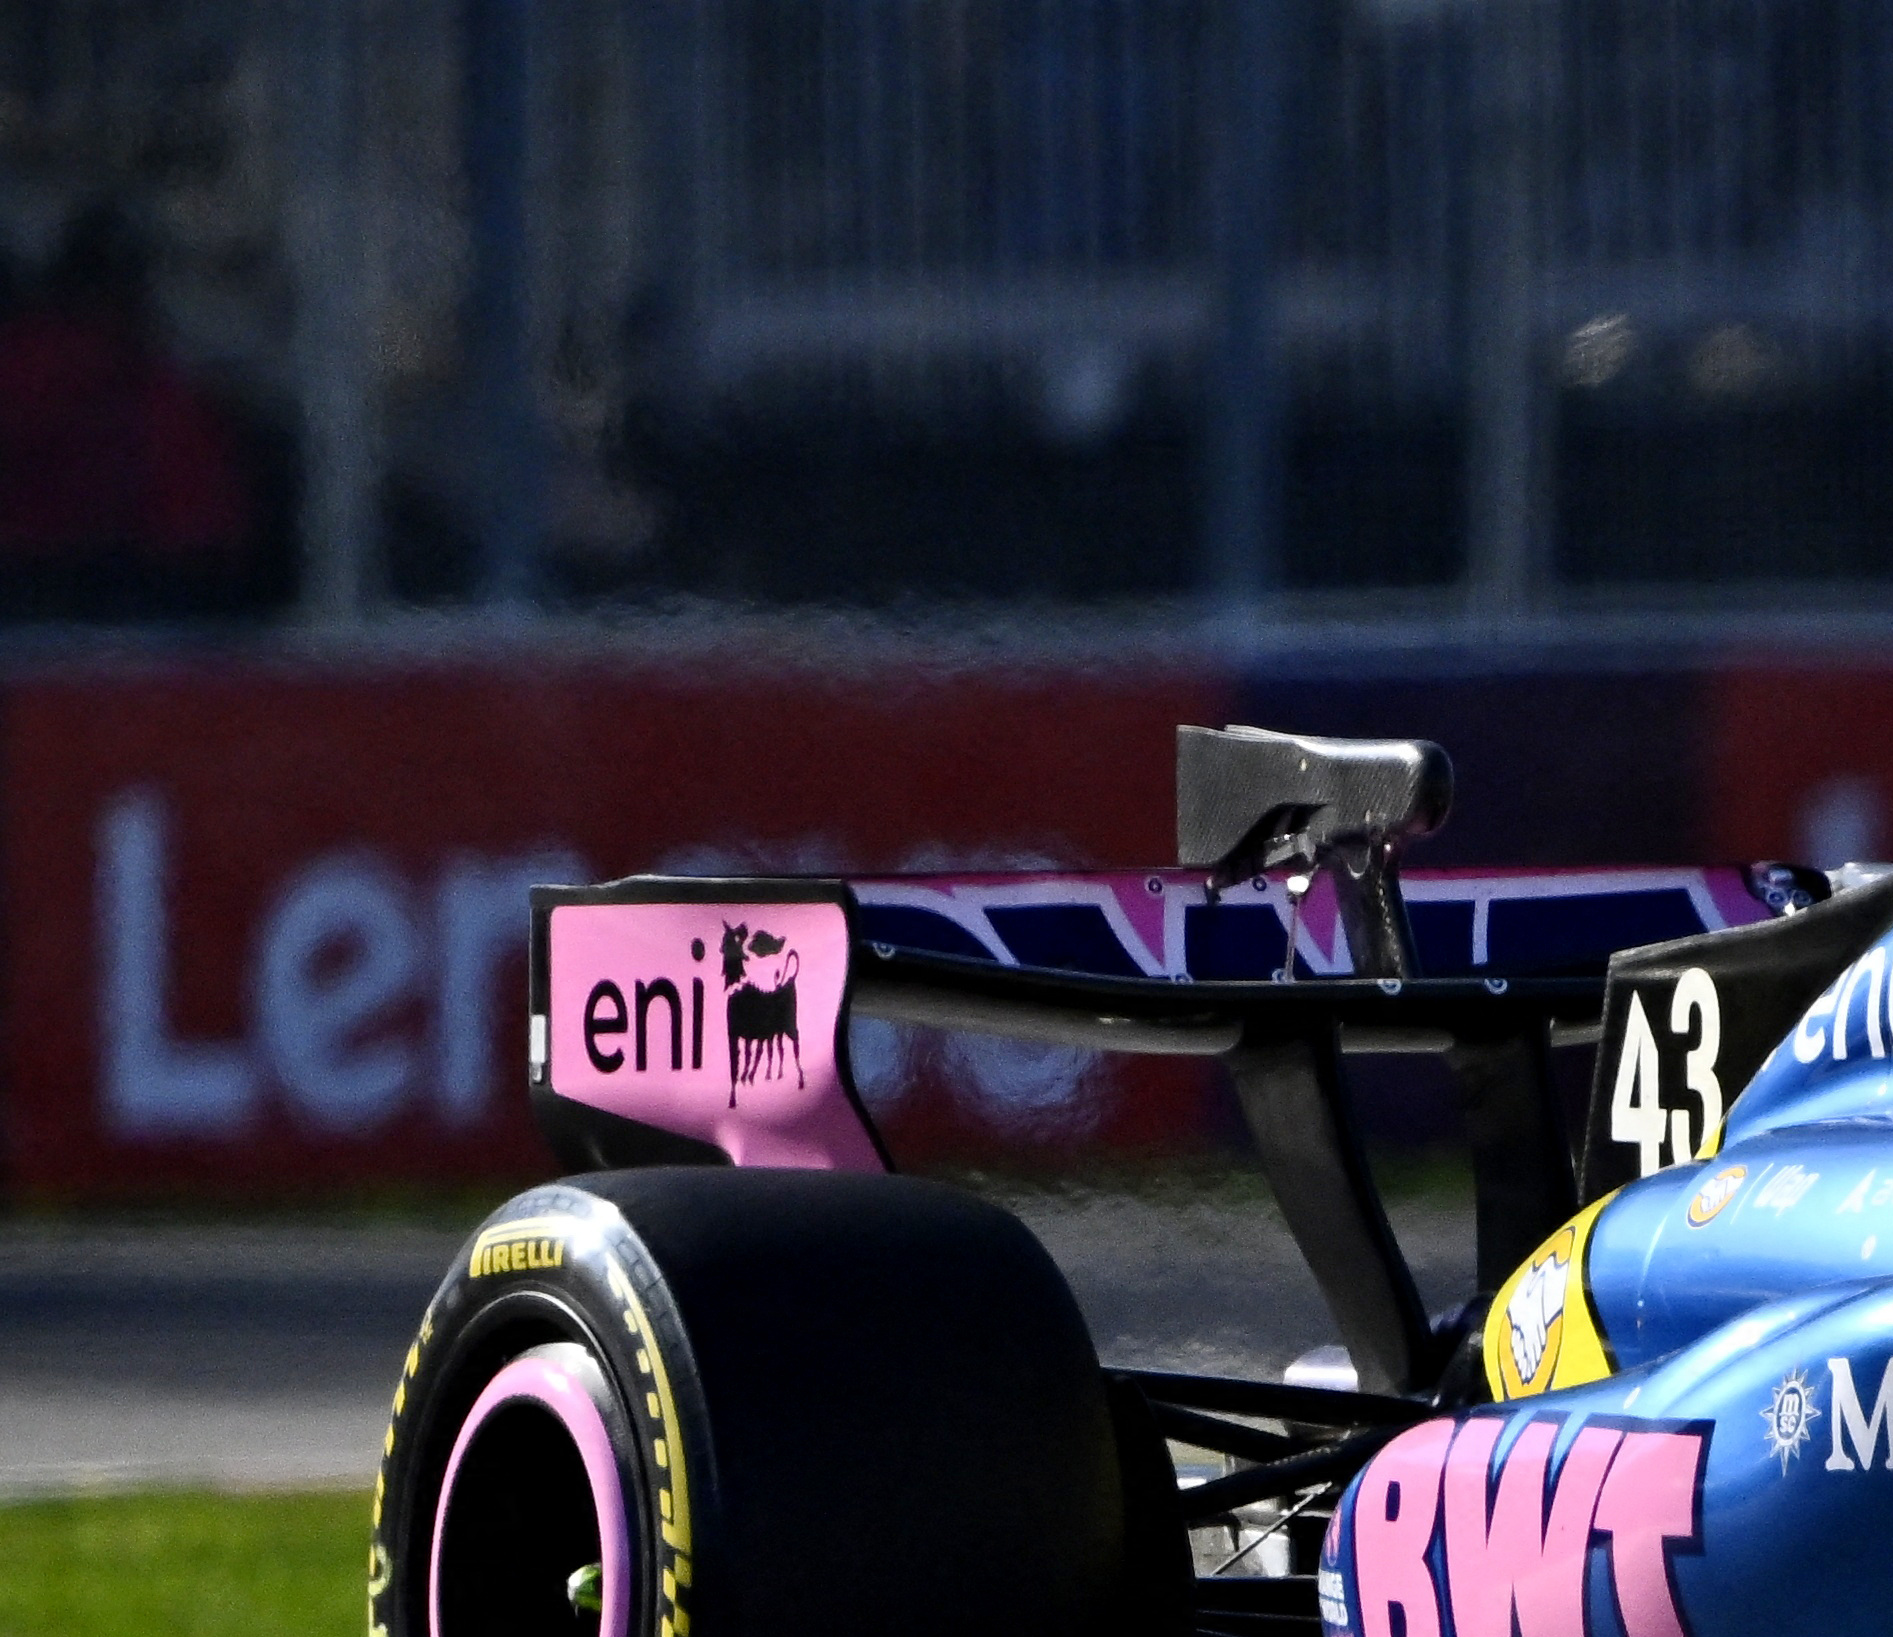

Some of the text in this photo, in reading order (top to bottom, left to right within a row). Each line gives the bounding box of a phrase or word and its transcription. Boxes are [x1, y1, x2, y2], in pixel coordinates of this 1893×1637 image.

[584, 938, 704, 1073] eni
[1611, 967, 1722, 1177] 43
[469, 1216, 570, 1278] PIRELLI
